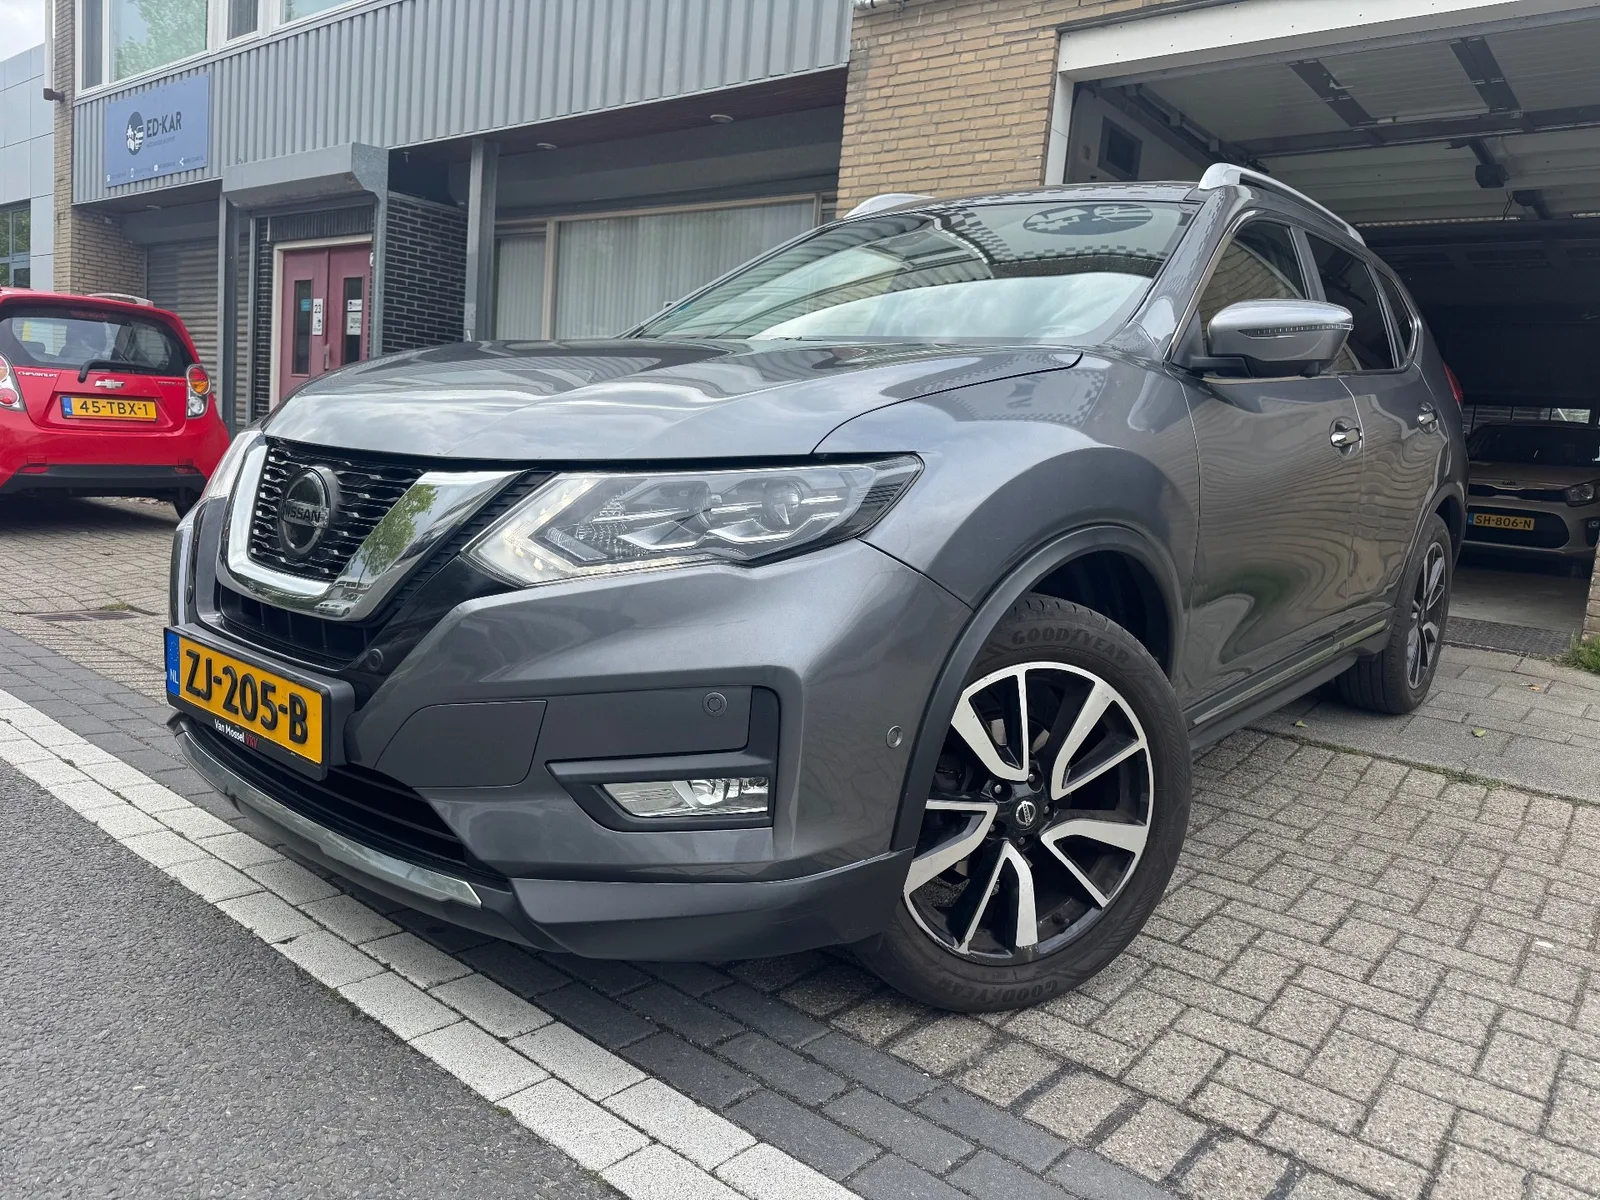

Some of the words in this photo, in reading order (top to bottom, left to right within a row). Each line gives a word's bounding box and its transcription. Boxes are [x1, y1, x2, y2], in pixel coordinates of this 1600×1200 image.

[146, 111, 182, 138] ED-KAR
[314, 304, 322, 314] 23
[79, 399, 149, 416] 45-TBX-1
[1475, 514, 1532, 529] SH-806-N
[1012, 627, 1131, 665] GOODYEAR
[169, 668, 179, 685] NL
[185, 648, 308, 745] ZJ-205-B
[214, 718, 225, 733] Van
[225, 724, 245, 743] Mossel
